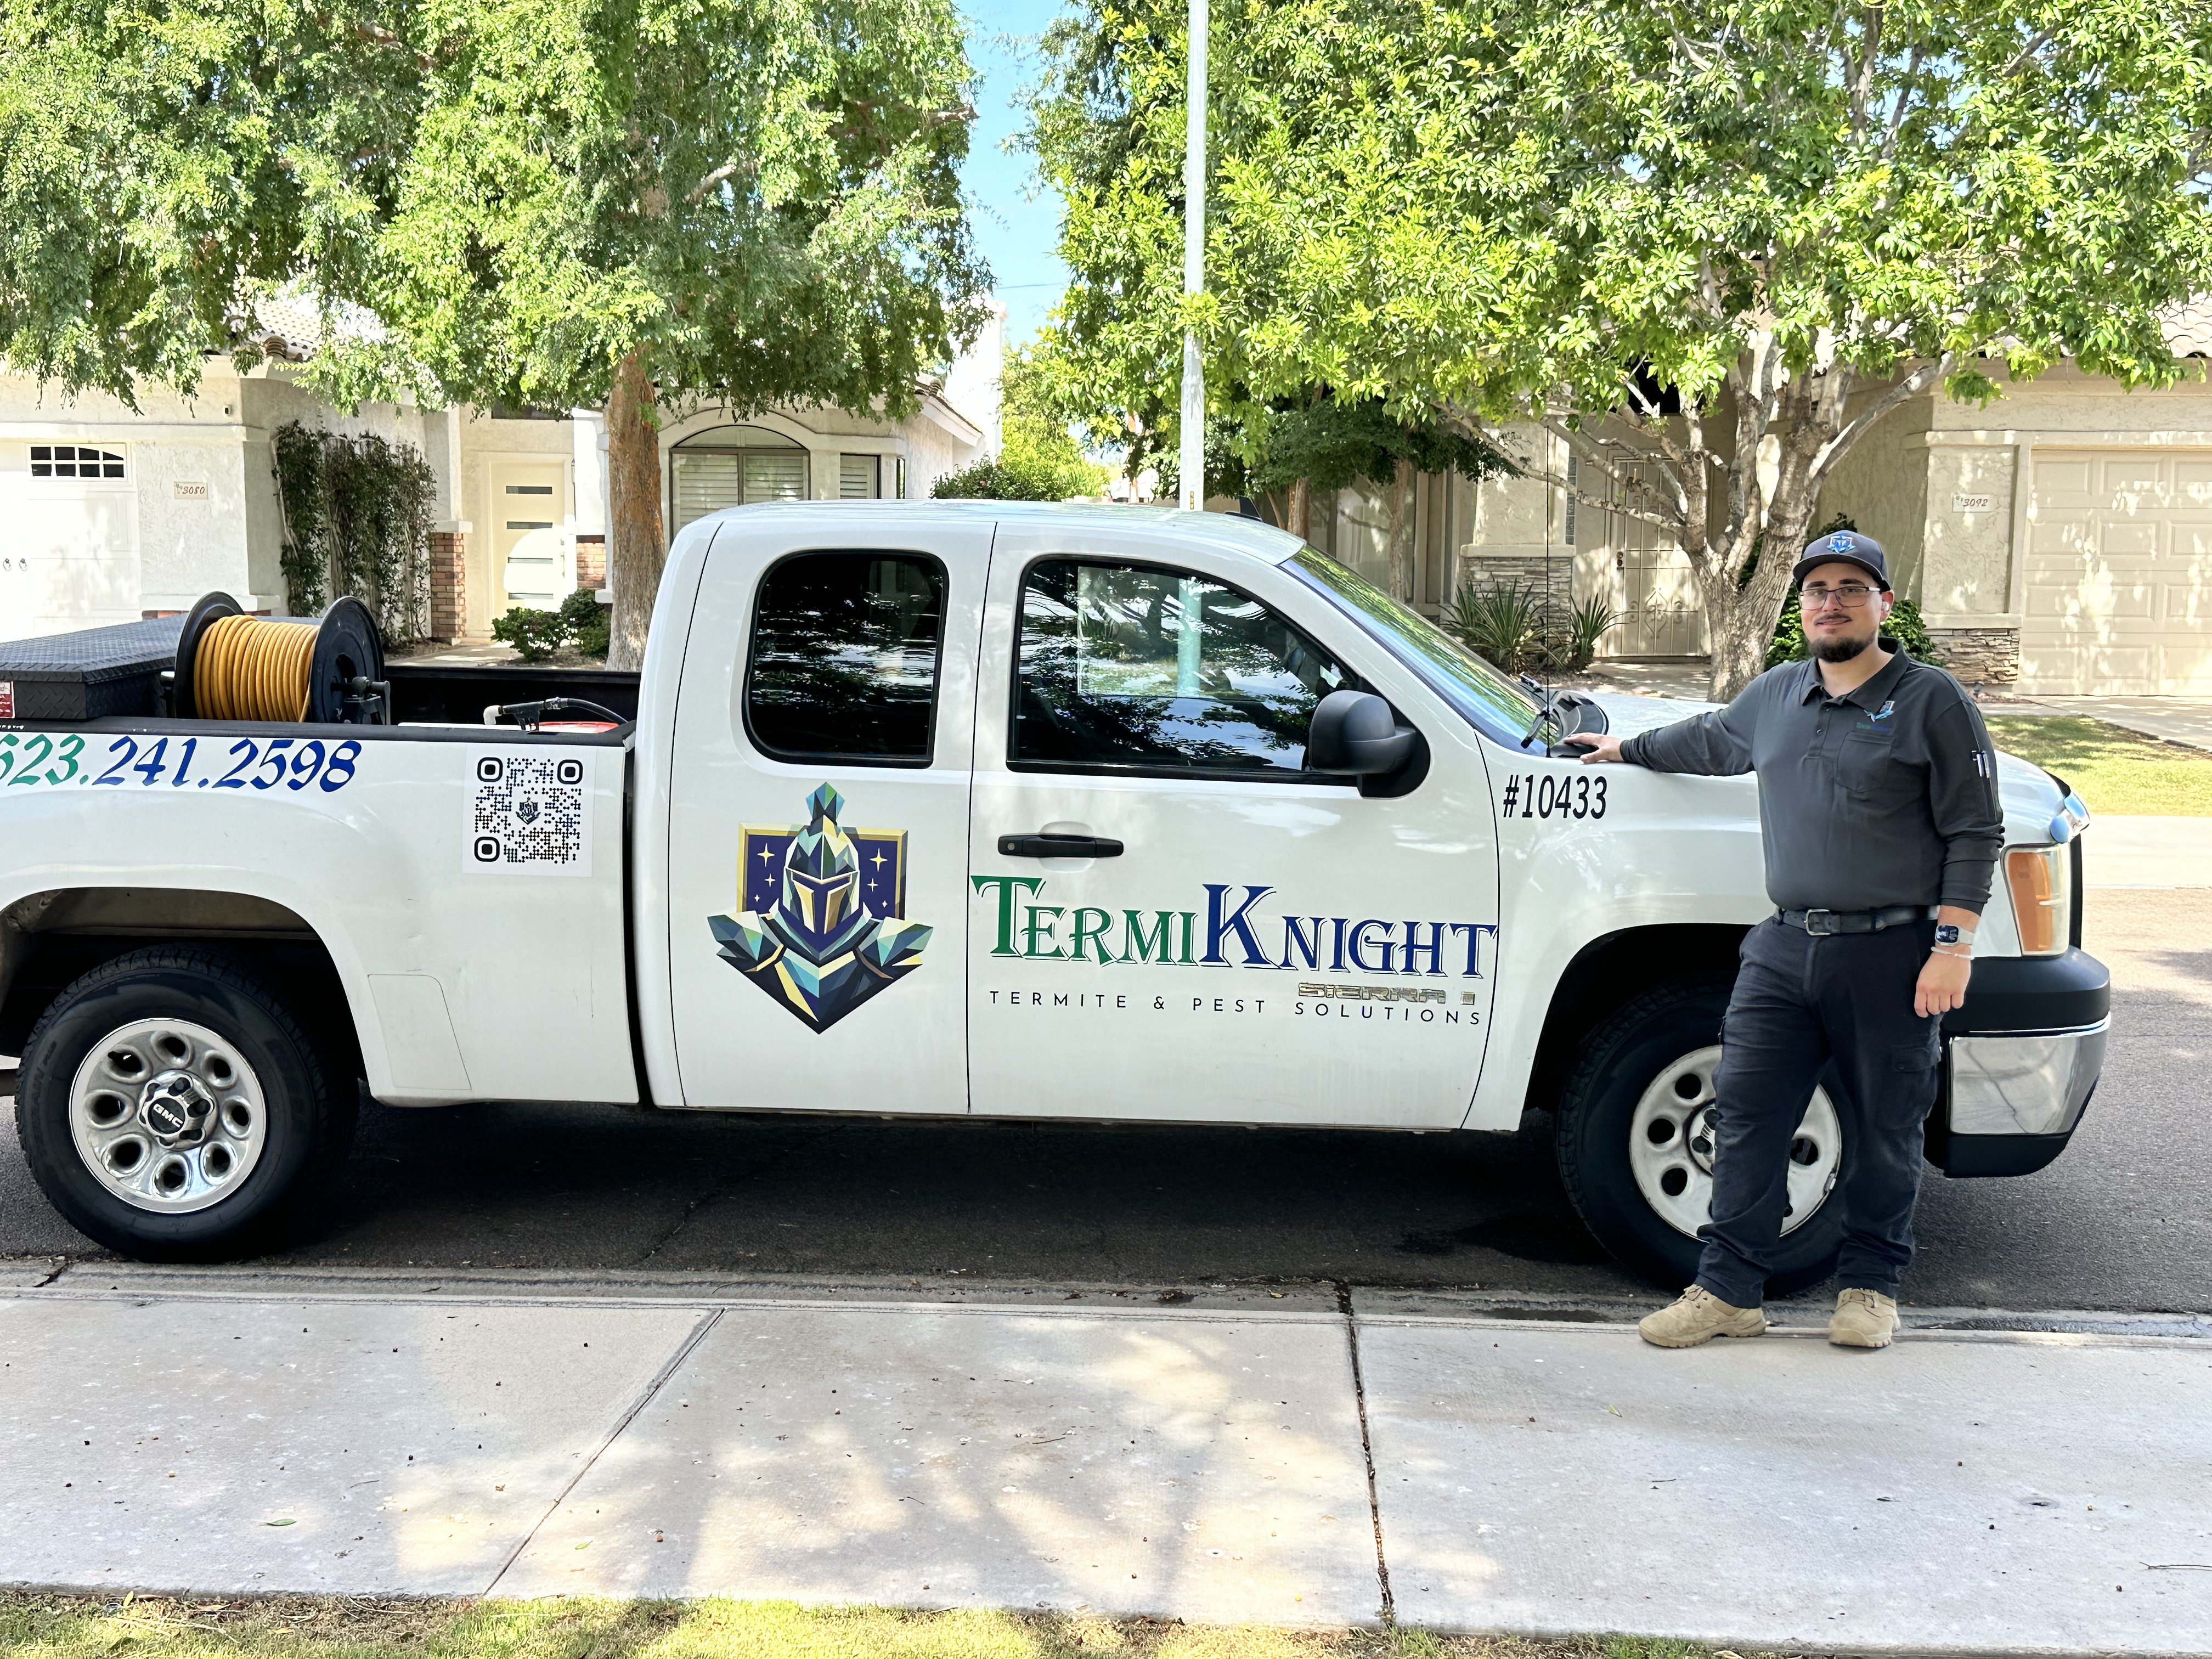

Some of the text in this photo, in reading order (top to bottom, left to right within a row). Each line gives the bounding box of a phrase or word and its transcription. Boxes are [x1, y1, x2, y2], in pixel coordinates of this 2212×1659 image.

[1503, 774, 1607, 819] #10433
[990, 991, 1480, 1025] TERMITE & PEST SOLUTIONS
[153, 1103, 183, 1128] GMC
